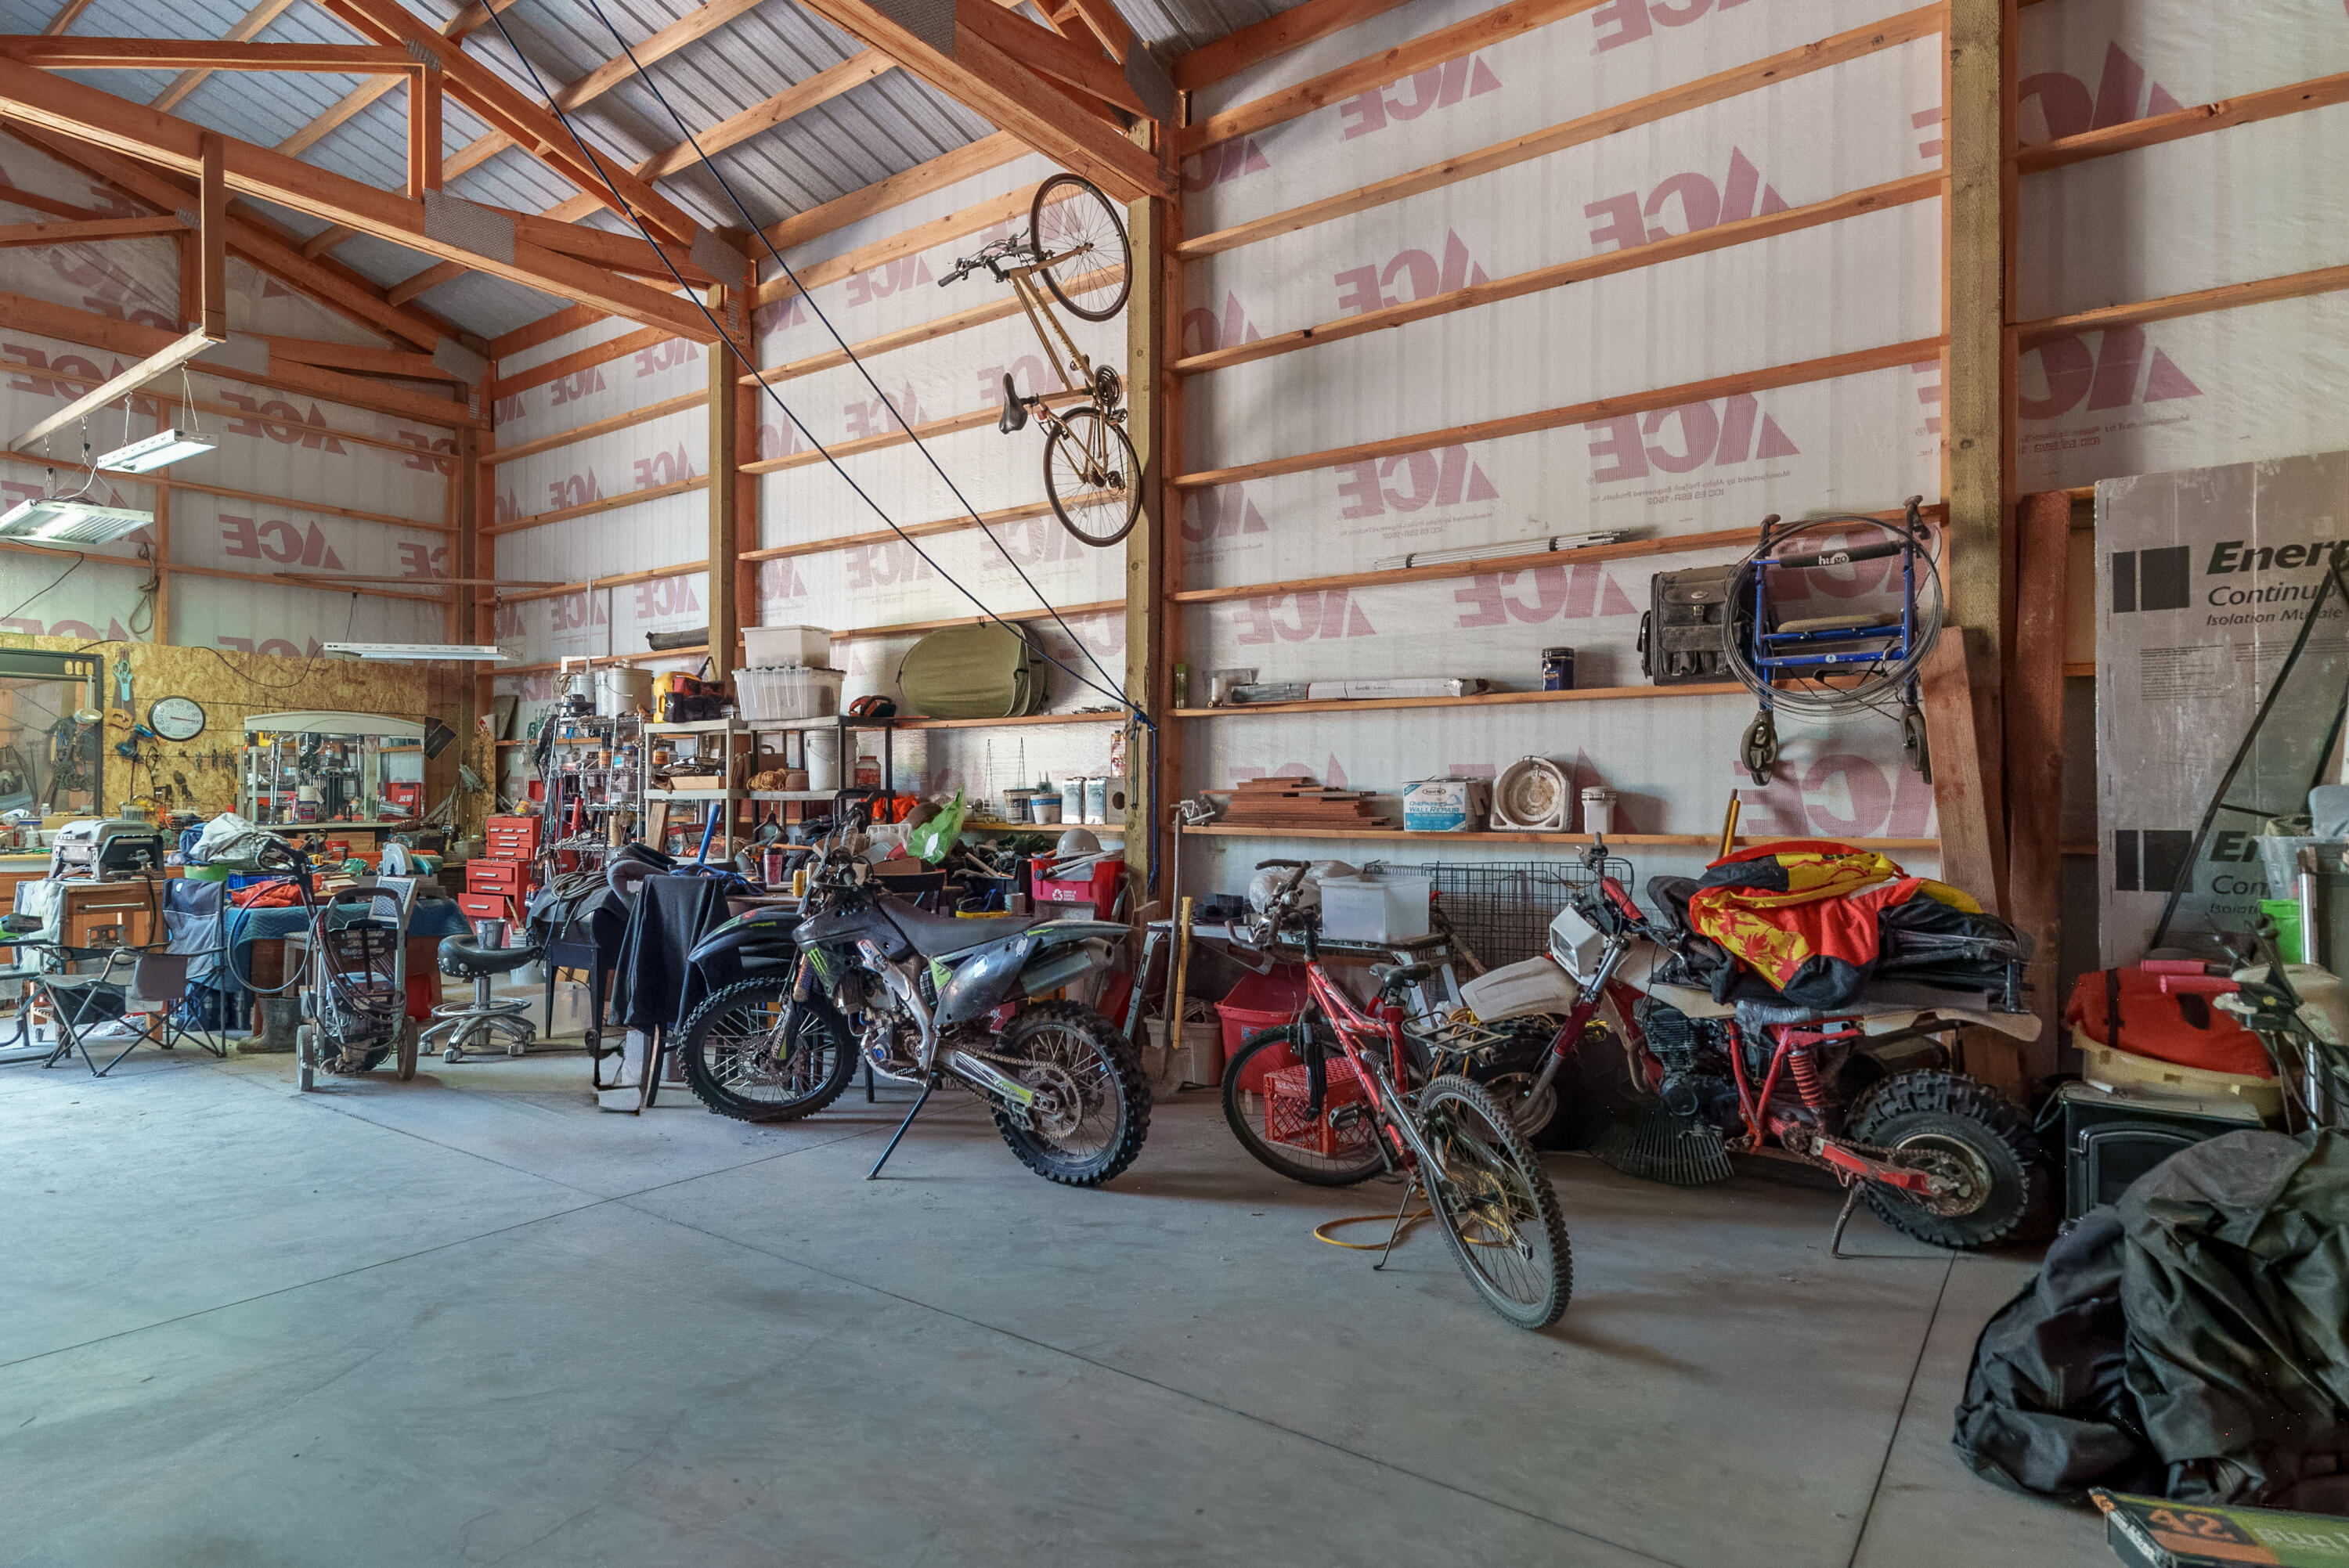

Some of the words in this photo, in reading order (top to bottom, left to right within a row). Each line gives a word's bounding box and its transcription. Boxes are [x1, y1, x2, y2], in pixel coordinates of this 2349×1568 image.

[2206, 613, 2276, 626] Isolation
[2279, 608, 2344, 622] Muale
[2149, 1509, 2237, 1541] 42
